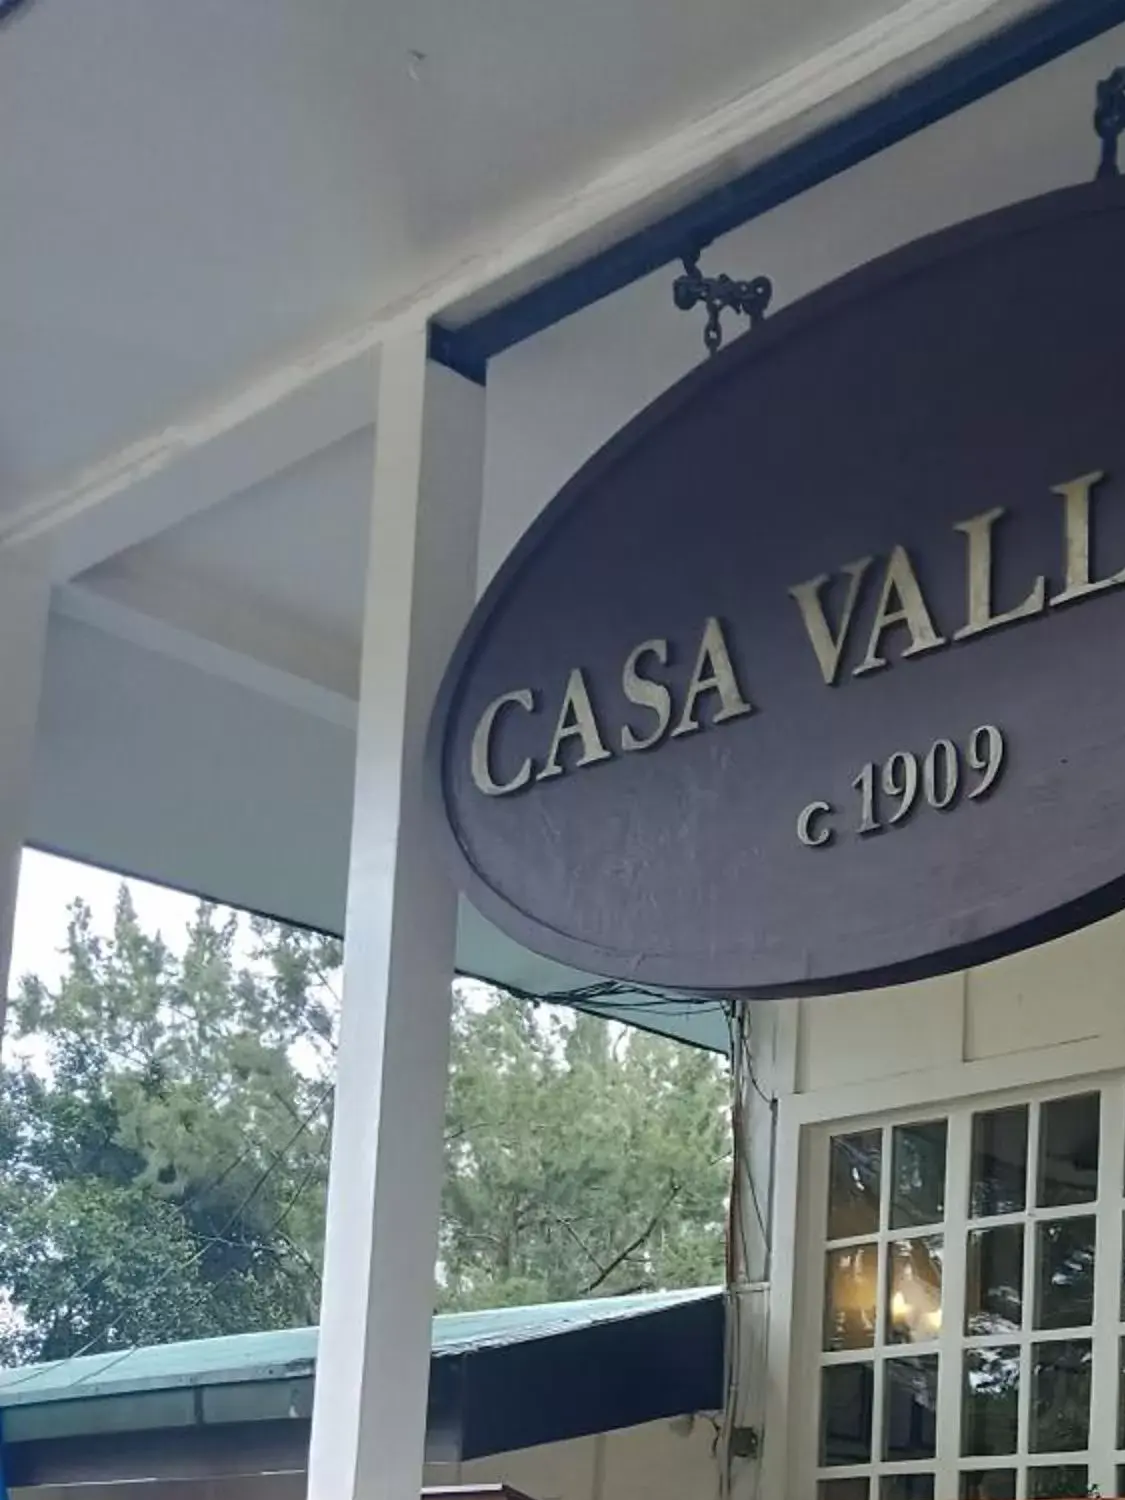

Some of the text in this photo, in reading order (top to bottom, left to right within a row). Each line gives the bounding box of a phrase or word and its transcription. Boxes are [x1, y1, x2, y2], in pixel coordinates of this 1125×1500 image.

[470, 616, 753, 796] CASA
[797, 724, 1005, 846] c 1909
